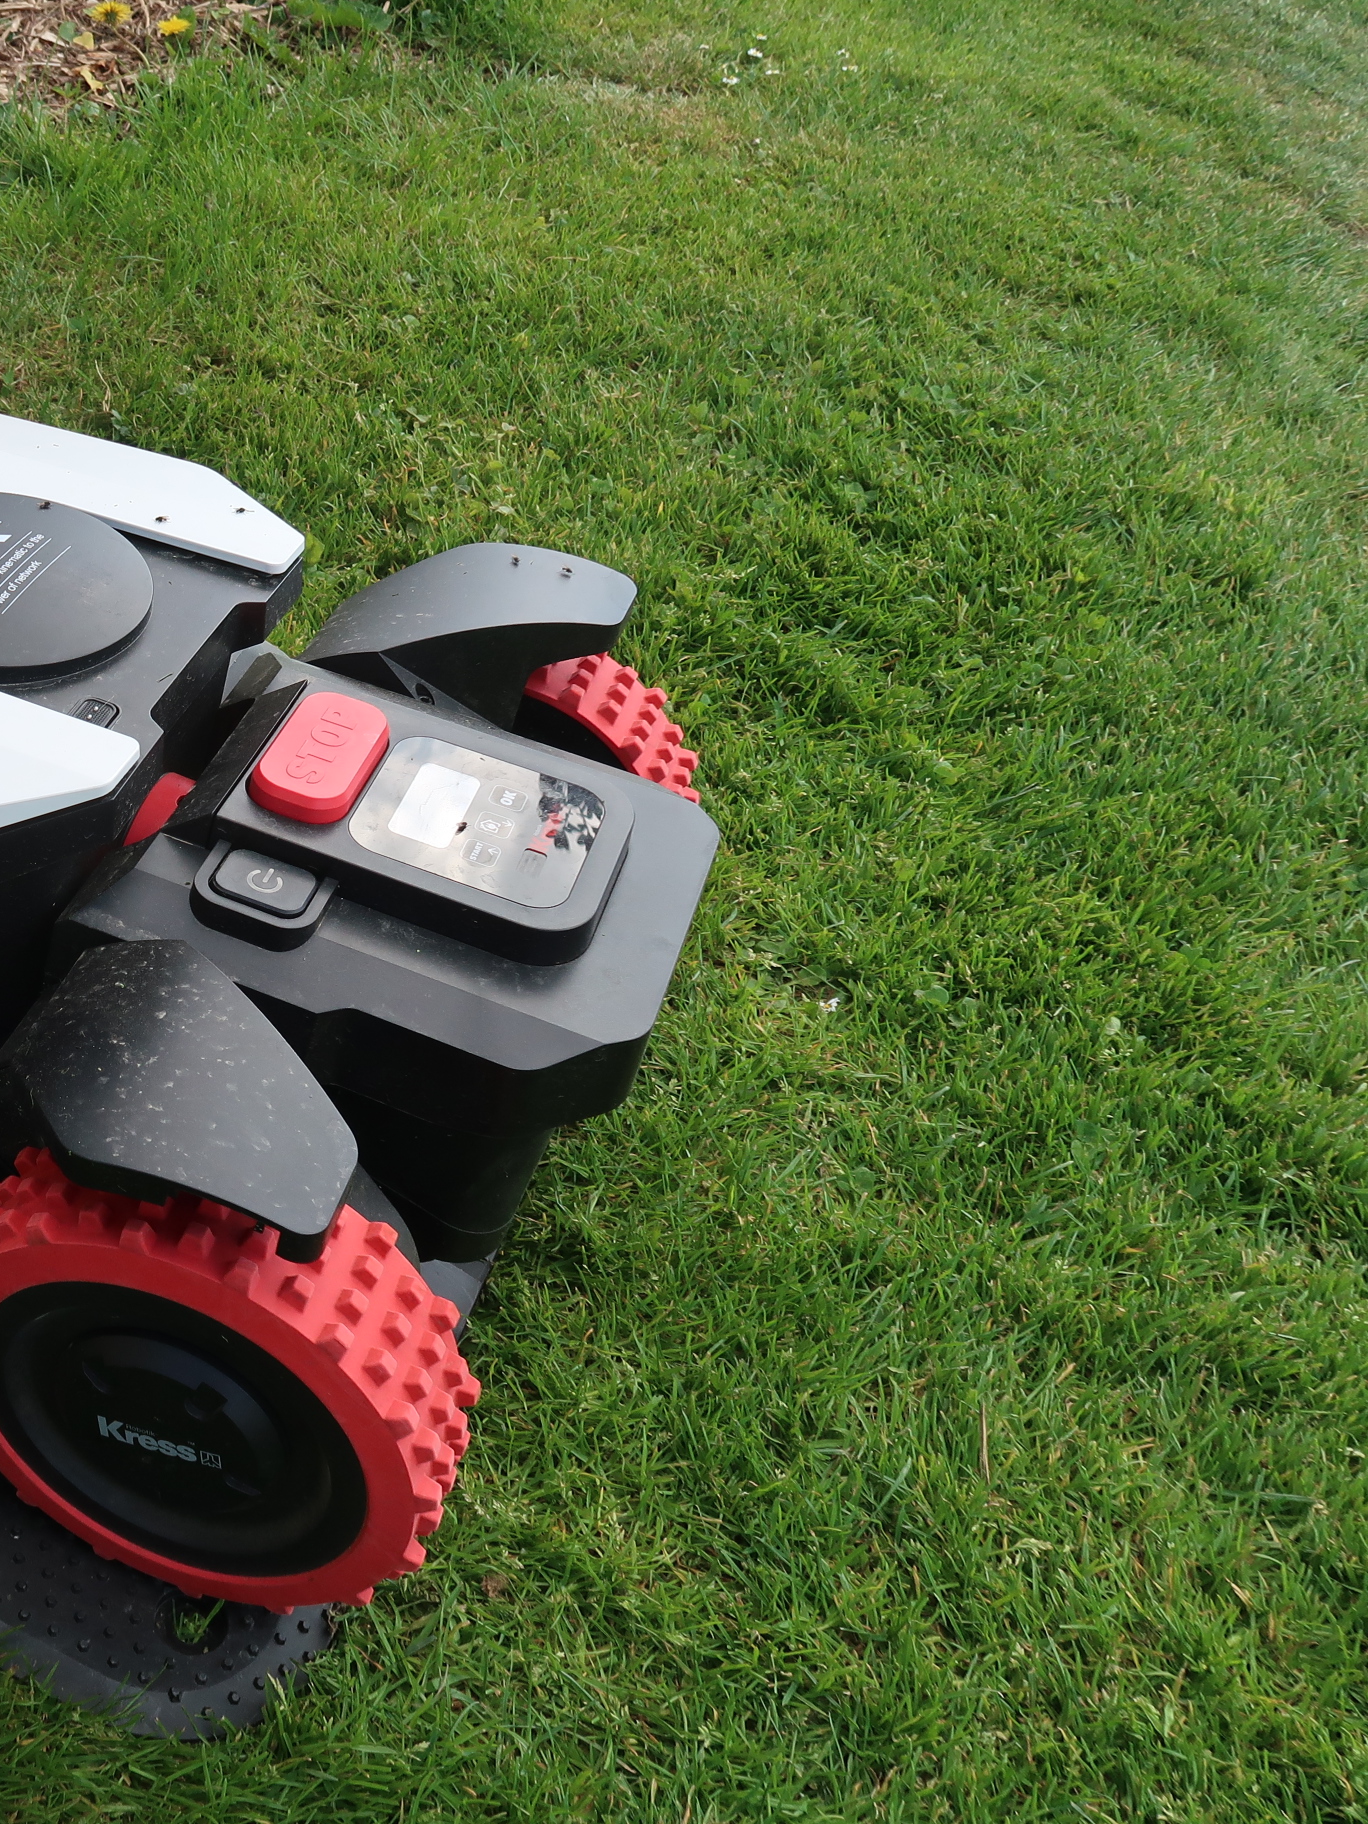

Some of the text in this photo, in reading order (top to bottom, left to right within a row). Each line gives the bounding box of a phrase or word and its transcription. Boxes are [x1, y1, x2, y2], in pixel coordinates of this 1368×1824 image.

[23, 540, 34, 550] to
[31, 533, 45, 545] the
[8, 581, 19, 592] of
[14, 560, 42, 585] network
[286, 706, 358, 785] STOP
[500, 790, 517, 806] OK
[470, 841, 484, 861] START
[97, 1415, 197, 1462] Kress
